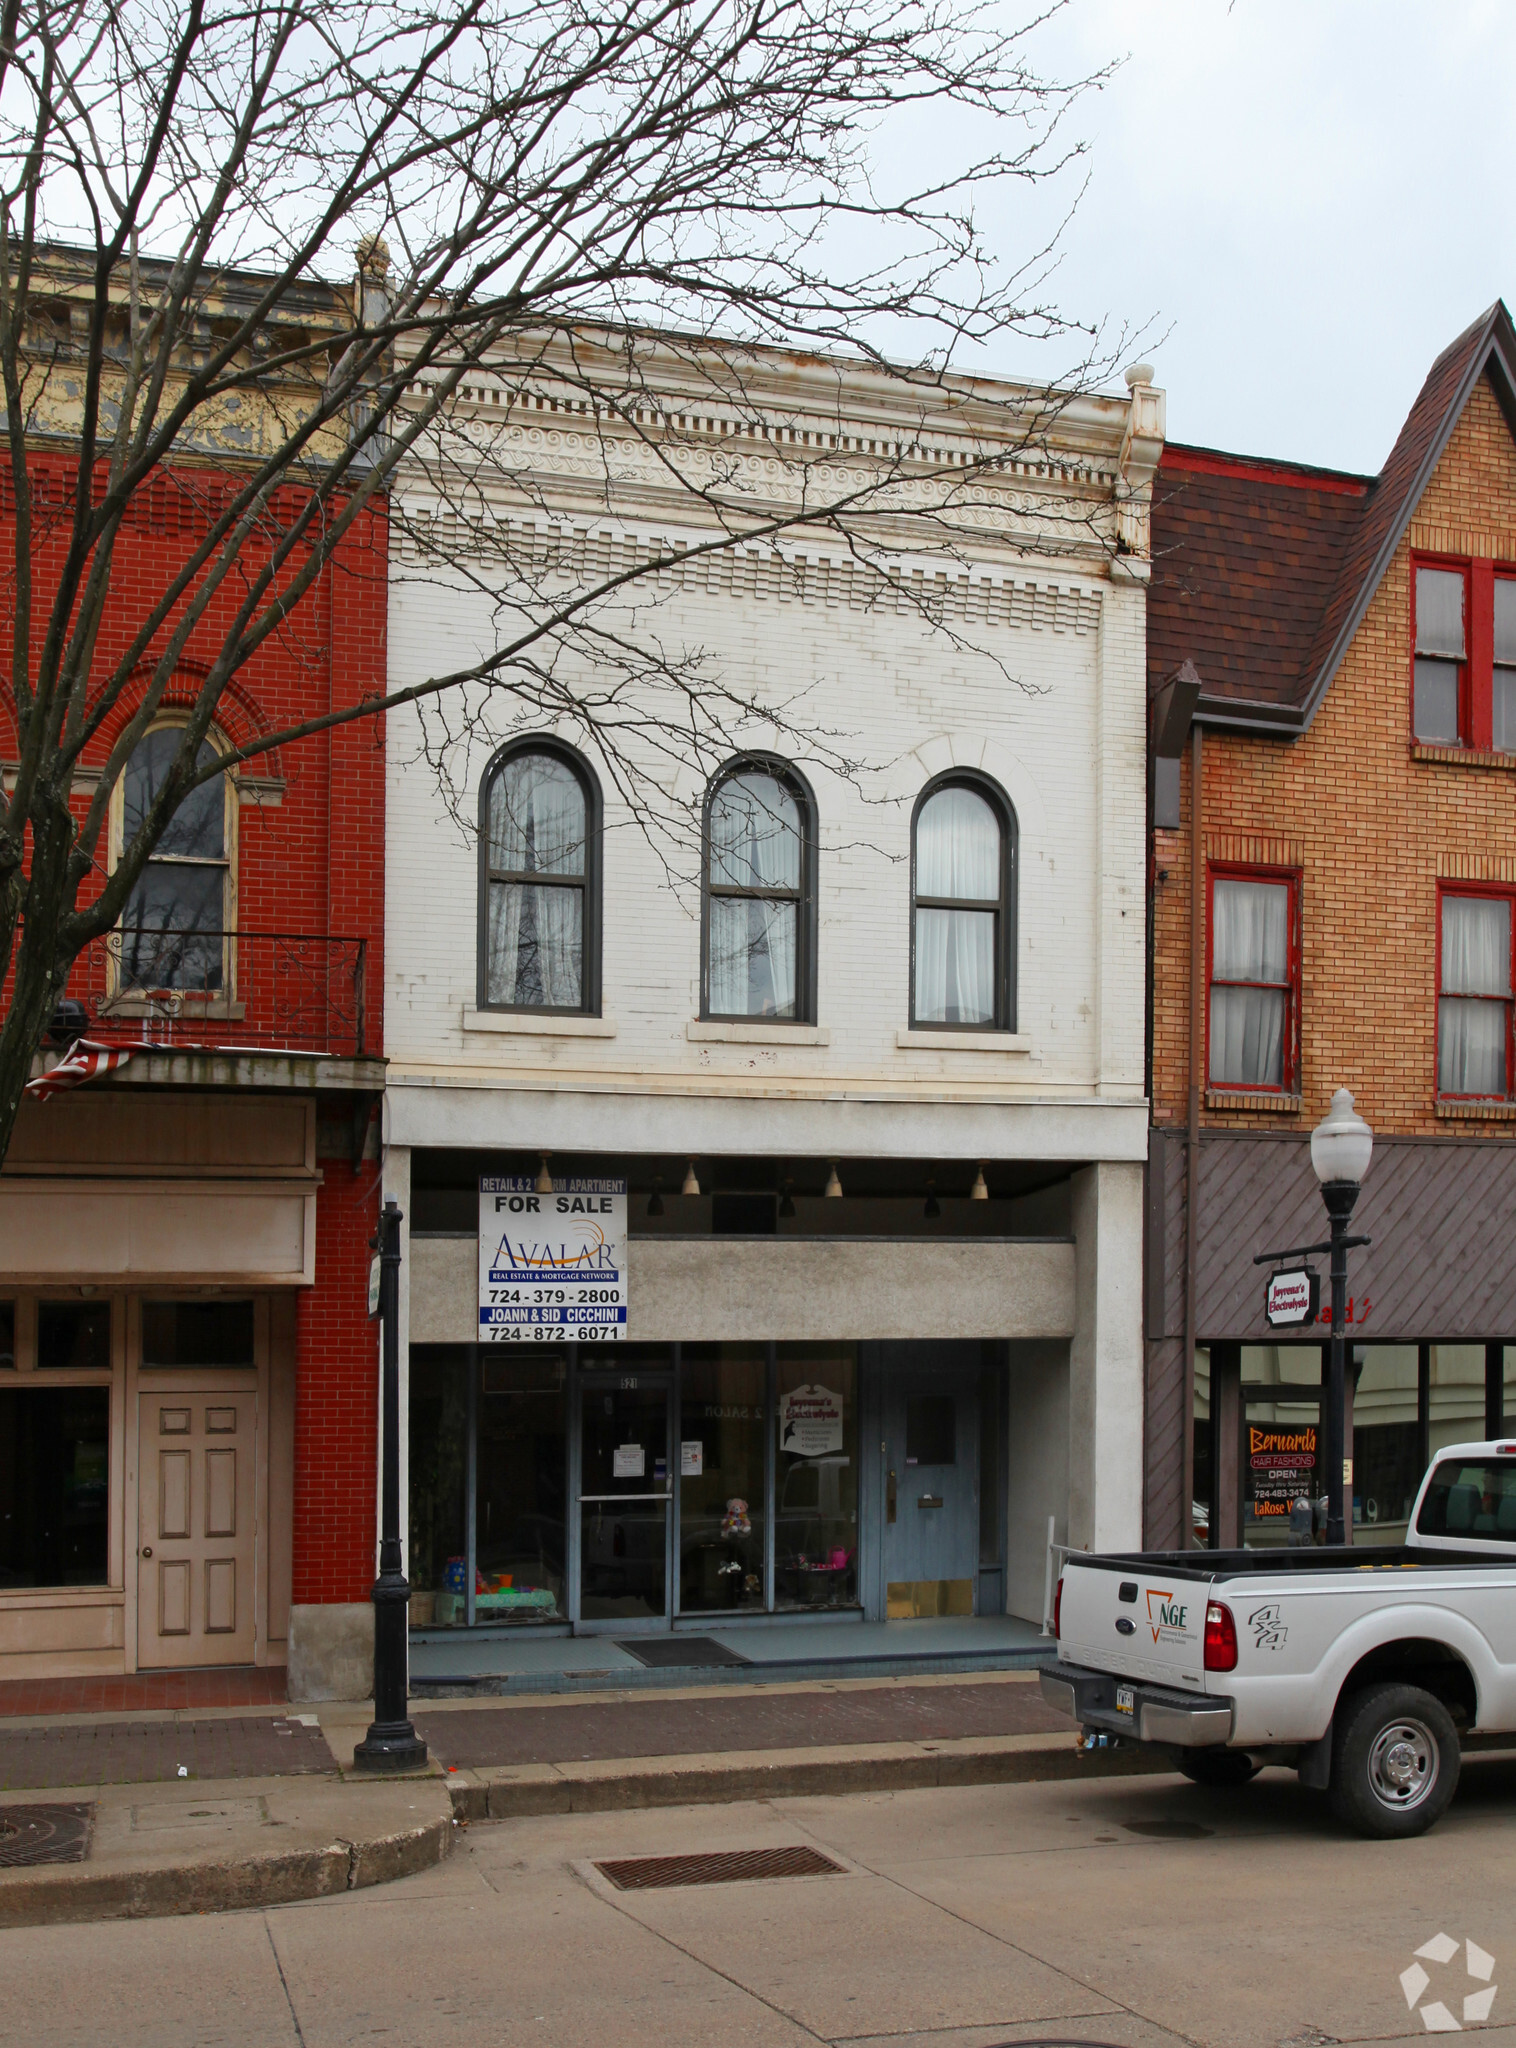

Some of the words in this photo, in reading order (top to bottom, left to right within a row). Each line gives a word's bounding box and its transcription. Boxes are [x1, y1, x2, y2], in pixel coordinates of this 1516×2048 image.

[482, 1178, 515, 1191] RETAIL
[518, 1179, 524, 1191] &
[525, 1178, 532, 1191] 2
[570, 1180, 624, 1193] APARTMENT
[495, 1196, 540, 1213] FOR
[556, 1197, 612, 1213] SALE
[492, 1272, 509, 1280] REAL
[510, 1272, 533, 1280] ESTATE
[542, 1272, 579, 1280] MORTGAGE
[1273, 1283, 1305, 1300] Joyrena's
[1269, 1297, 1308, 1314] Electrolysis
[488, 1308, 529, 1322] JOANN
[531, 1309, 539, 1322] &
[541, 1308, 560, 1322] SID
[567, 1308, 618, 1321] CICCHINI
[620, 1377, 638, 1389] 521
[1249, 1427, 1317, 1454] Bernard's
[1253, 1457, 1272, 1466] HAIR
[1273, 1456, 1312, 1466] FASHIONS
[1268, 1470, 1297, 1479] OPEN
[1287, 1480, 1309, 1488] Saturday
[1254, 1488, 1309, 1498] 724-483-3474
[1254, 1500, 1285, 1515] LaRose
[1160, 1603, 1188, 1628] NGE
[1083, 1649, 1128, 1672] SUPER
[1135, 1660, 1175, 1681] DUTY
